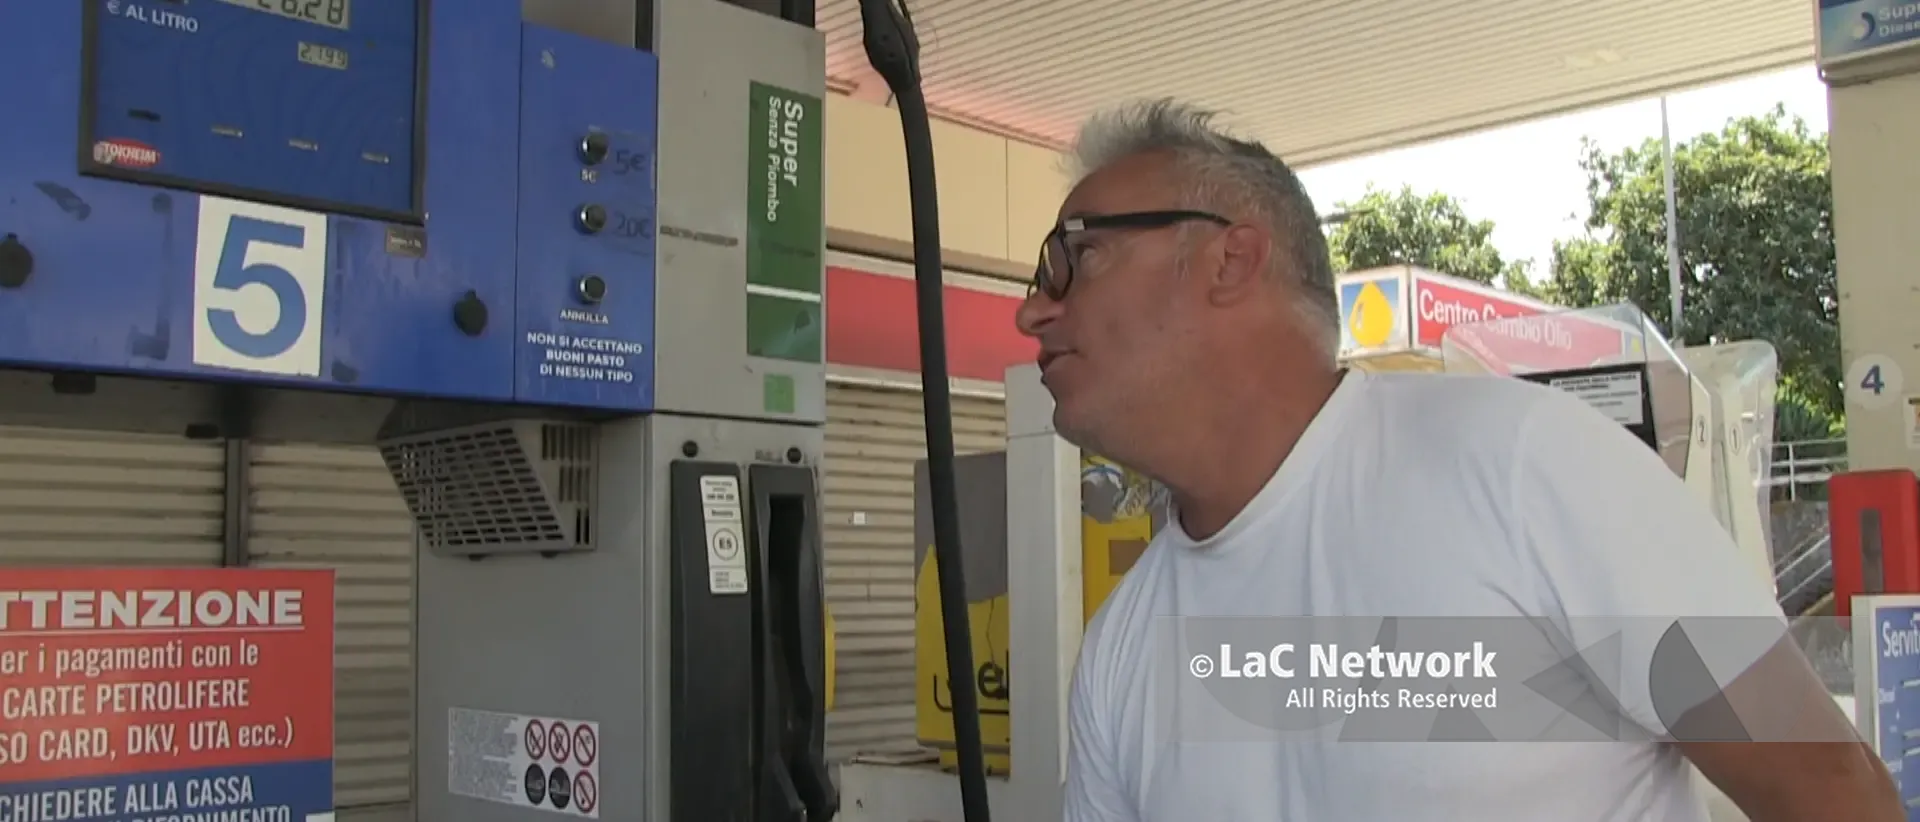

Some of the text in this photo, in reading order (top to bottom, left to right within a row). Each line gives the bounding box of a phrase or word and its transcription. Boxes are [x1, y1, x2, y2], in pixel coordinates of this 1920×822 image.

[126, 4, 148, 21] AL
[152, 11, 198, 32] LITRO
[767, 95, 782, 222] Senza Piombo
[779, 99, 804, 187] Super
[206, 213, 307, 359] 5
[560, 308, 609, 325] ANNULLA
[1419, 288, 1572, 351] Centro Cambio Olio
[527, 331, 643, 355] NON SI ACCETTANO
[546, 349, 625, 367] BUONI PASTO
[540, 362, 633, 384] DI NESSUN TIPO
[1860, 364, 1885, 395] 4
[38, 642, 45, 673] i
[55, 639, 183, 680] pagamenti
[191, 644, 232, 668] con
[239, 637, 259, 666] le
[3, 677, 250, 720] CARTE PETROLIFERE
[39, 727, 117, 762] CARD,
[127, 723, 180, 757] DKV,
[188, 720, 231, 751] UTA
[238, 715, 294, 749] ecc.)
[0, 785, 117, 822] CHIEDERE
[124, 779, 179, 814] ALLA
[186, 775, 253, 808] CASSA
